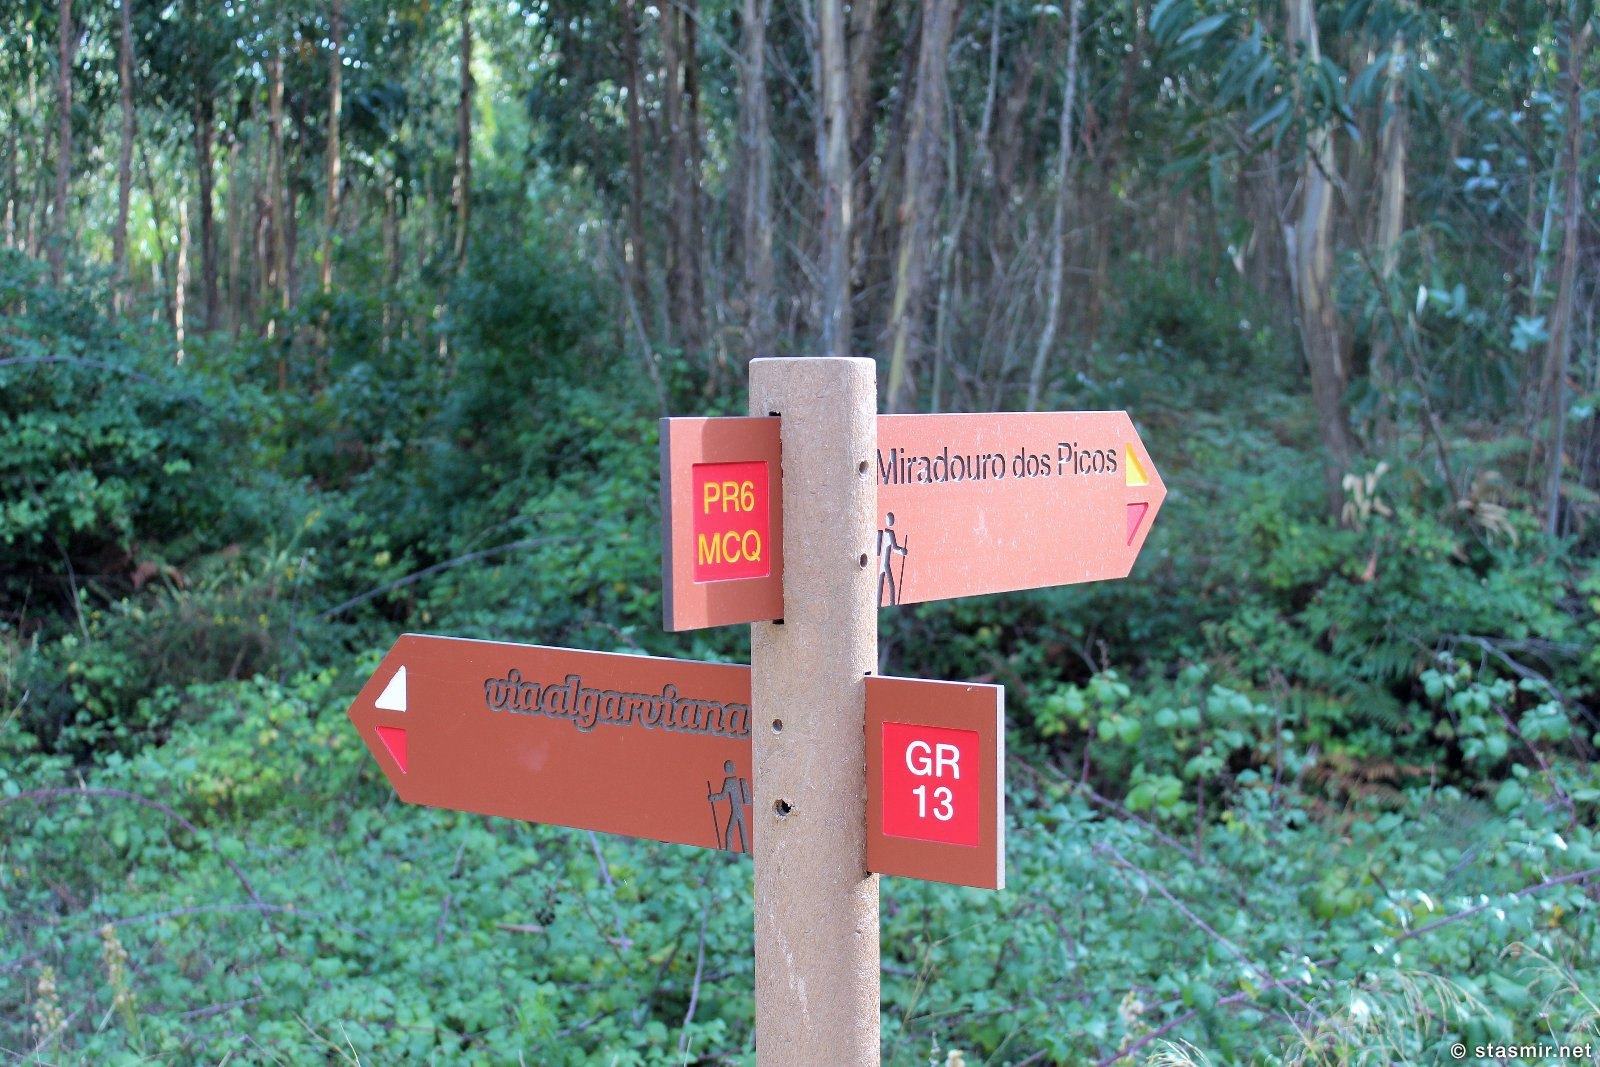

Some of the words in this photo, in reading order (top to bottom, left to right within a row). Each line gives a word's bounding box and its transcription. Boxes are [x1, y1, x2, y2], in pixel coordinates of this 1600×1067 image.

[877, 447, 1006, 485] Miradouro
[1012, 447, 1051, 479] dos
[1057, 442, 1117, 476] Picos
[703, 480, 755, 514] PR6
[698, 529, 761, 566] MCQ
[905, 740, 960, 780] GR
[912, 784, 954, 821] 13
